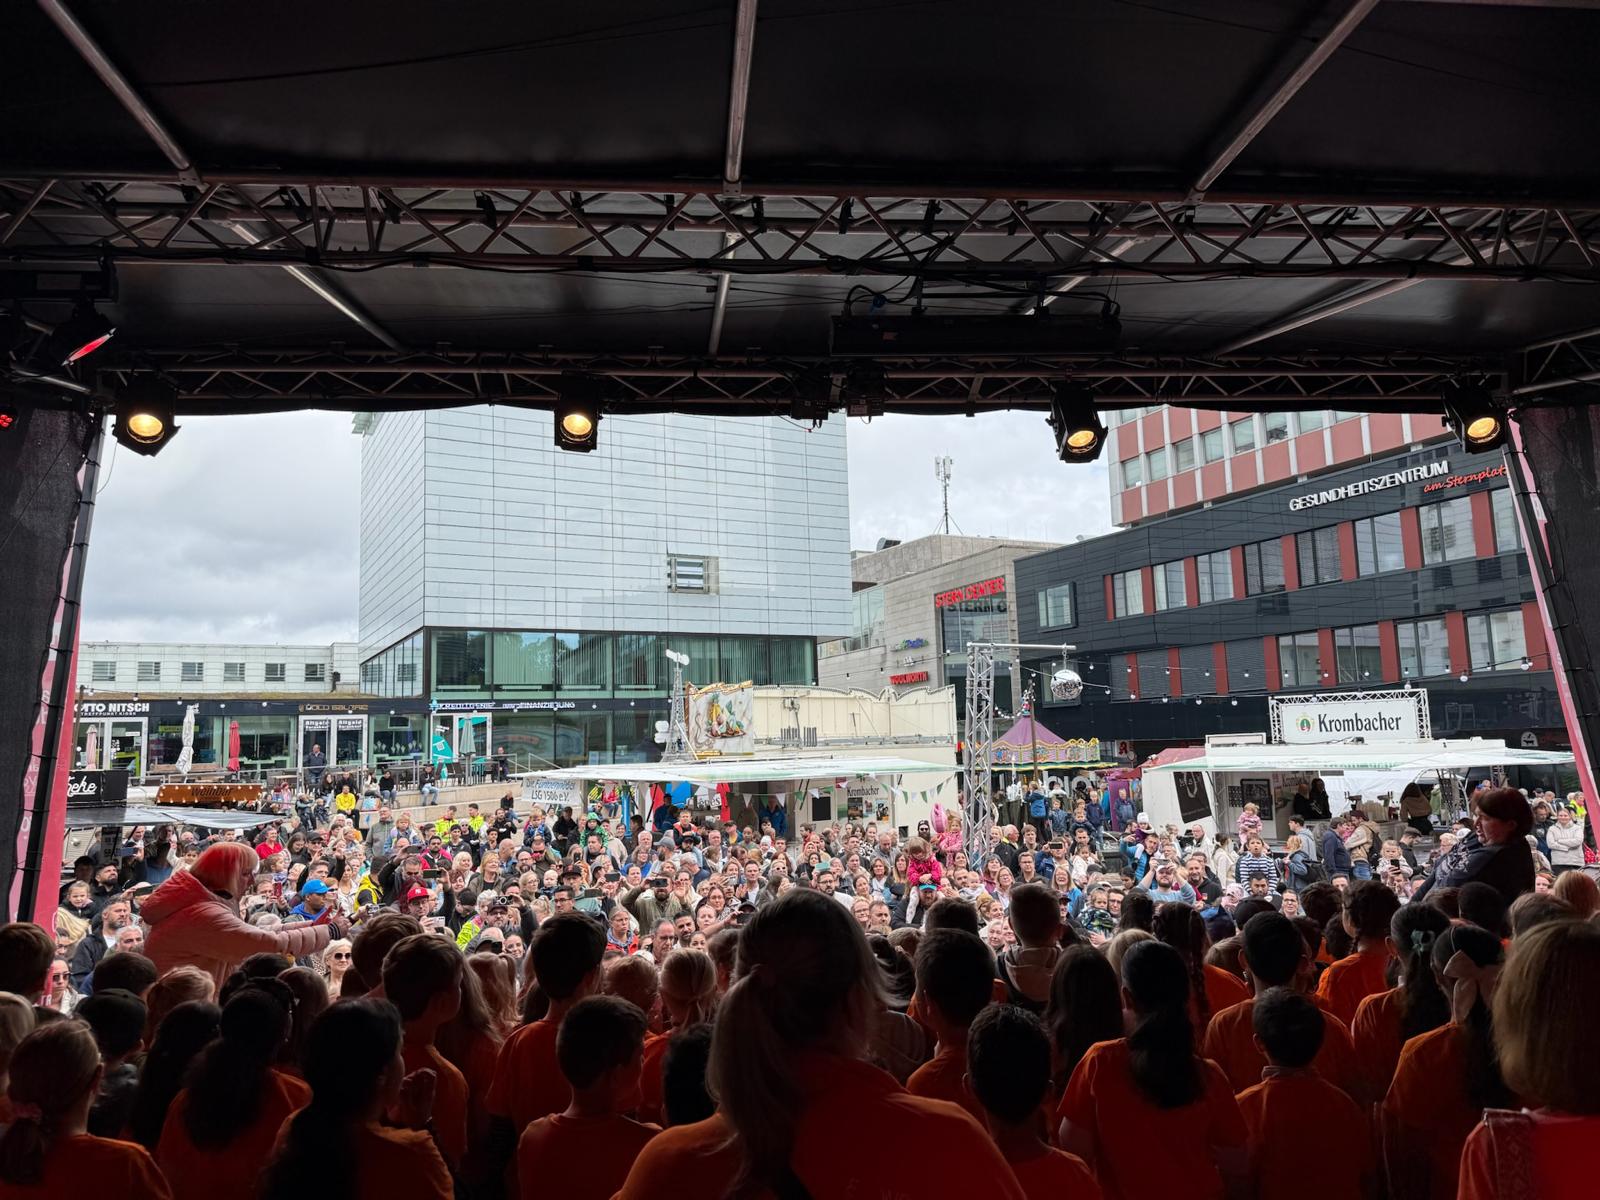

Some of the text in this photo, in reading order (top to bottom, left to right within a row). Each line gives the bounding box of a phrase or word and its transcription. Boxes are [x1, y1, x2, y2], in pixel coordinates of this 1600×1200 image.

[1289, 460, 1449, 511] GESUNDHEITSZENTRUM
[1423, 465, 1508, 493] am Sternplat
[935, 577, 1006, 608] STERN CENTER
[108, 702, 150, 712] NITSCH
[1318, 712, 1402, 733] Krombacher
[847, 785, 880, 797] Krombacher
